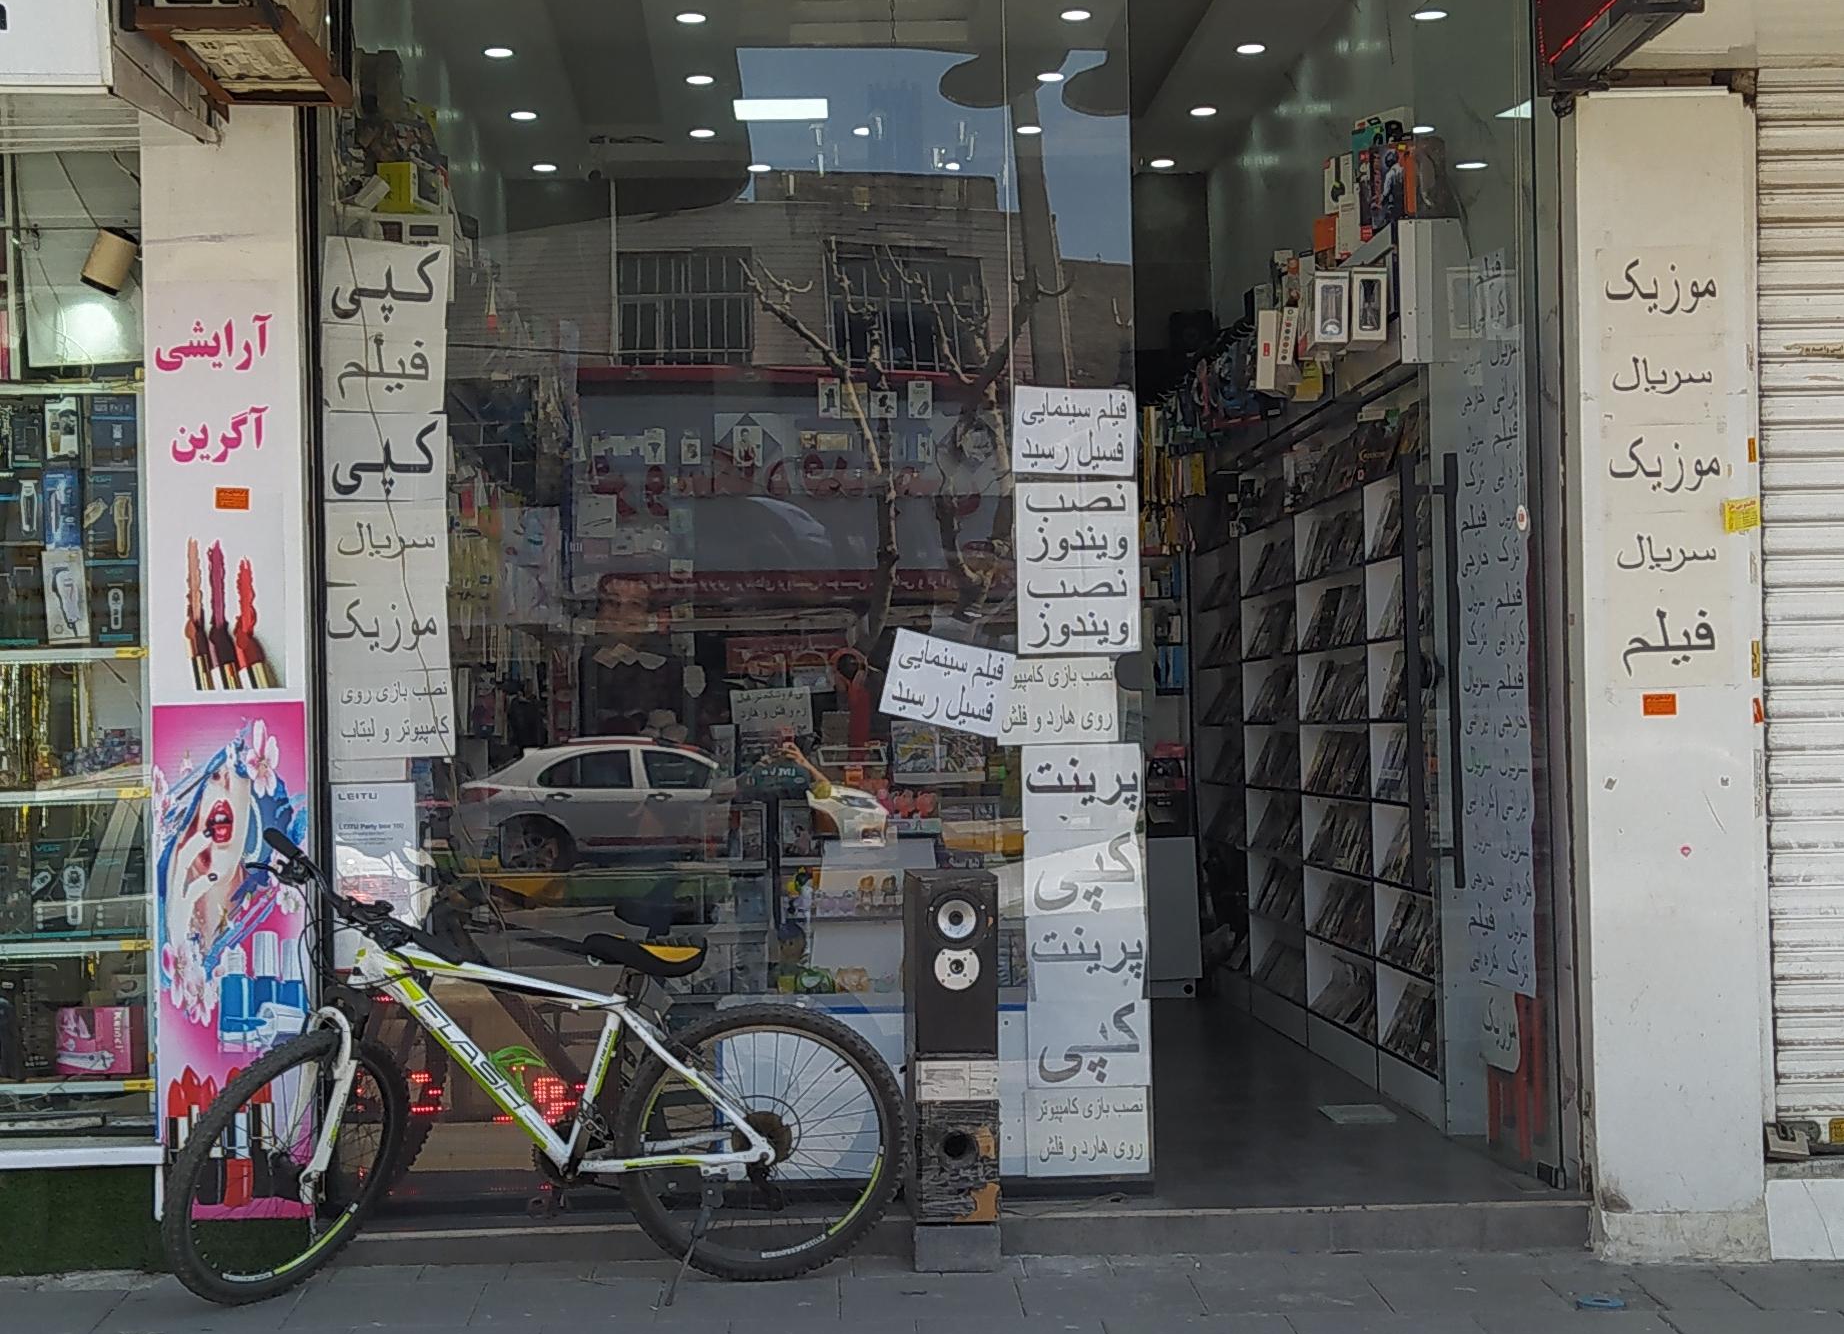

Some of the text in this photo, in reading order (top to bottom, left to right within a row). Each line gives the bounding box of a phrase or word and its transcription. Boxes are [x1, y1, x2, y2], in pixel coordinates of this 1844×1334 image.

[332, 249, 442, 324] کپی
[1605, 258, 1718, 316] موزیک
[155, 313, 272, 372] آرایشی
[337, 335, 429, 399] فیلم
[1612, 356, 1713, 395] سریال
[1021, 391, 1128, 430] فیلم سینمایی
[171, 405, 269, 464] آگرین
[1020, 429, 1125, 471] فسیل رسید
[332, 419, 440, 497] کپی
[1609, 436, 1721, 494] موزیک
[1026, 483, 1128, 524] نصب
[338, 521, 436, 560] سریال
[1025, 524, 1129, 564] ویندوز
[1617, 533, 1718, 572] سریال
[1026, 569, 1128, 609] نصب
[327, 598, 438, 654] موزیک
[1027, 608, 1130, 649] ویندوز
[1622, 606, 1716, 677] فیلم
[897, 639, 1006, 683] فیلم سینمایی
[1048, 664, 1079, 688] بازی
[1081, 664, 1114, 685] نصب
[340, 680, 448, 705] نصب بازی روی
[891, 681, 995, 726] فسیل رسید
[380, 726, 391, 744] و
[396, 715, 450, 745] کامپیوتر
[1001, 704, 1114, 734] روی هارد و فلش
[338, 791, 378, 801] LEITU
[1026, 756, 1140, 813] پرینت
[1033, 831, 1137, 914] کپی
[1030, 926, 1145, 980] پرینت
[415, 999, 528, 1111] FLASH
[1037, 1002, 1141, 1085] کپی
[1035, 1096, 1145, 1126] نصب بازی کامپیوتر
[1038, 1134, 1145, 1161] روی هارد و فلش
